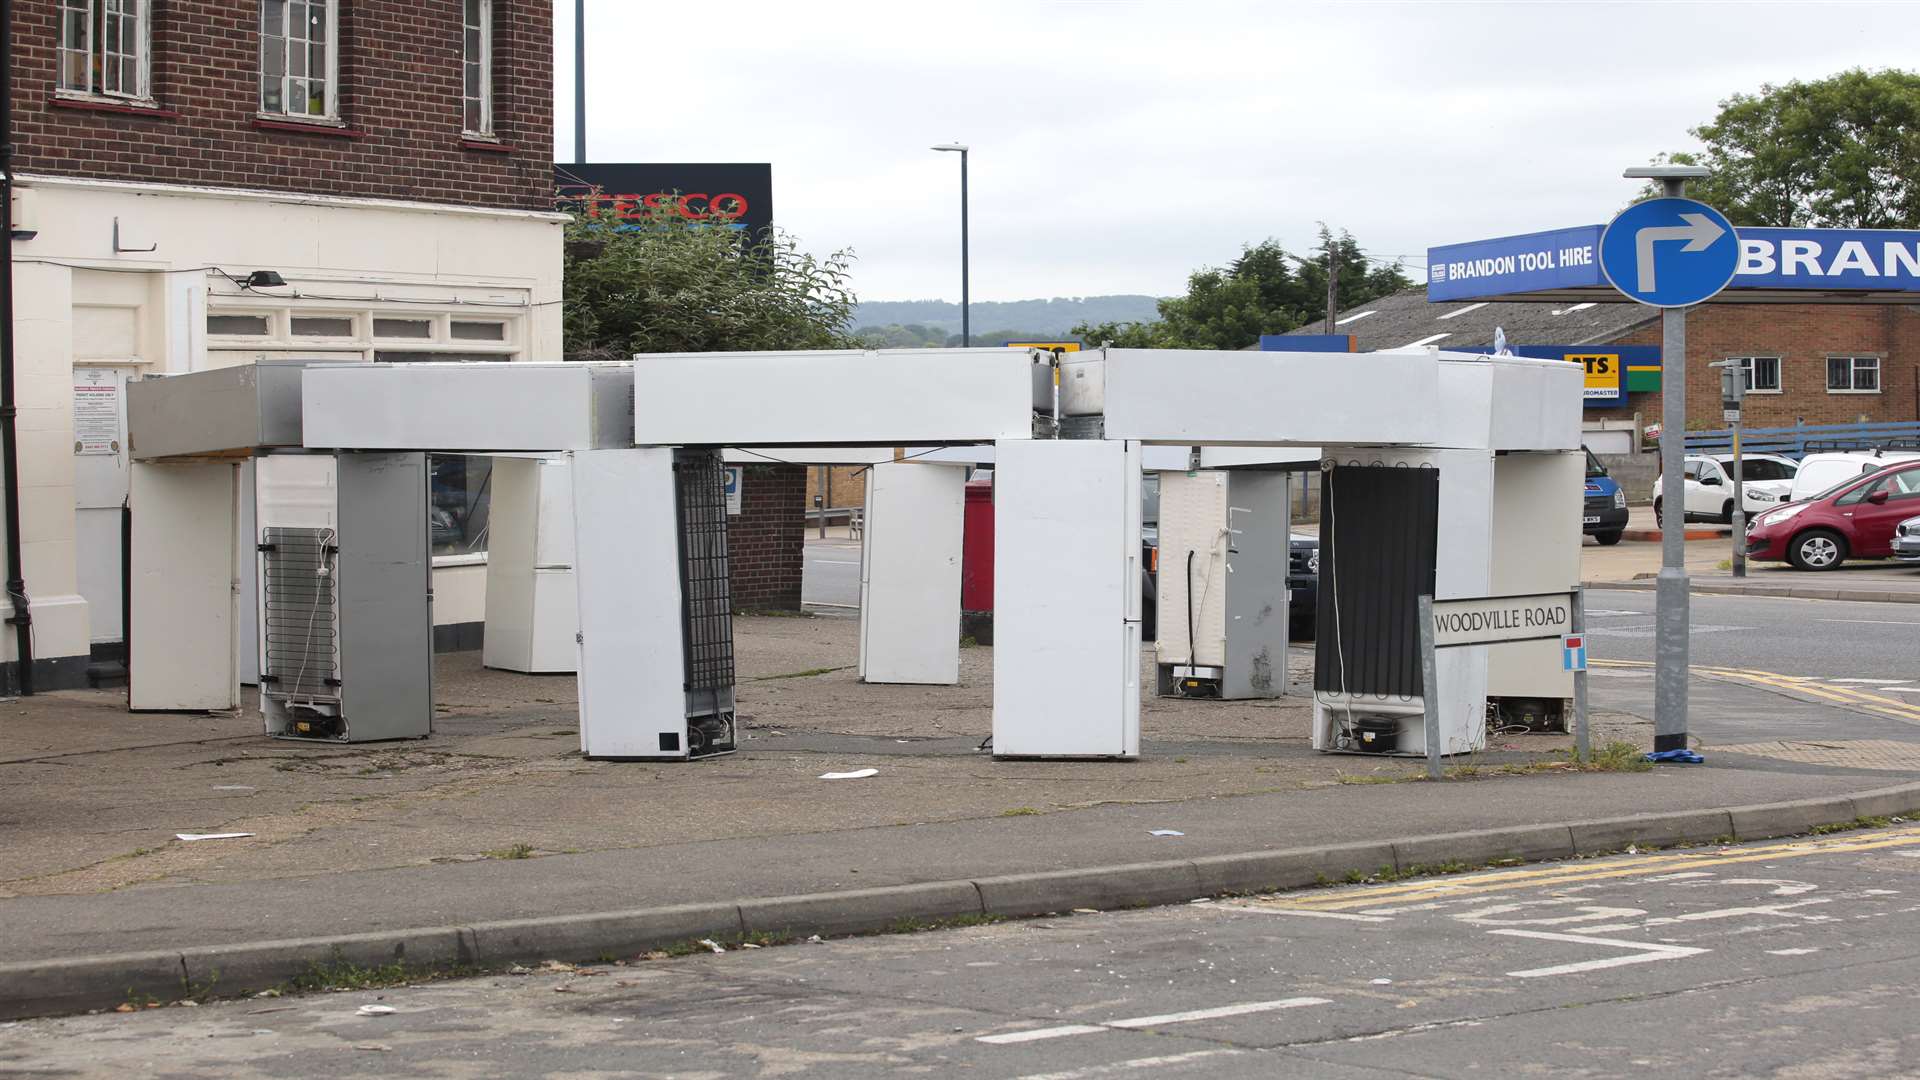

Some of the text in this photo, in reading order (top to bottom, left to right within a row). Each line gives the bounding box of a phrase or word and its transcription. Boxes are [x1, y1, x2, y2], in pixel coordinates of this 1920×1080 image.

[570, 193, 748, 219] TESCO
[1449, 255, 1515, 281] BRANDON
[1518, 250, 1556, 273] TOOL
[1559, 246, 1593, 268] HIRE
[1735, 239, 1920, 277] BRAN
[1434, 606, 1566, 633] WOODVILLE ROAD
